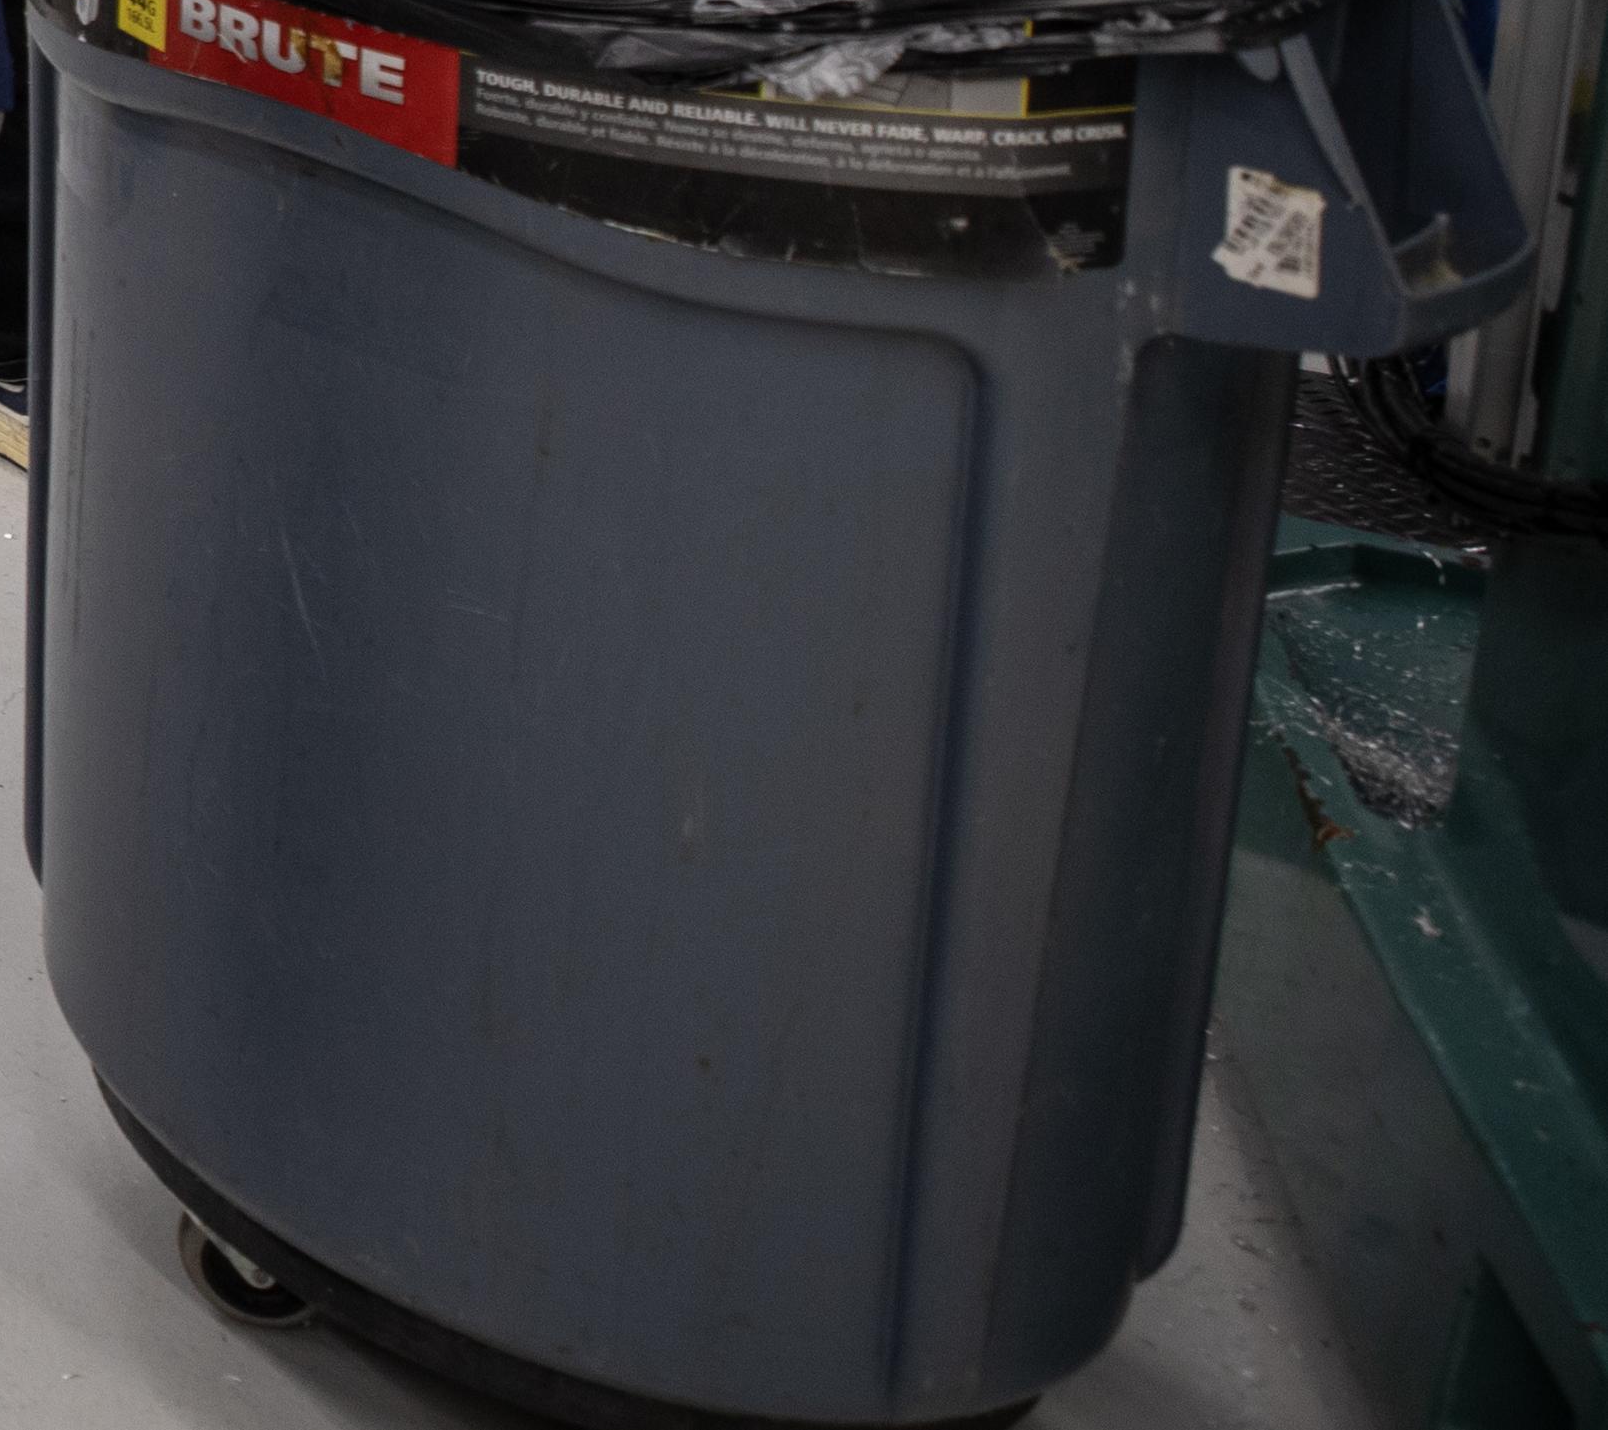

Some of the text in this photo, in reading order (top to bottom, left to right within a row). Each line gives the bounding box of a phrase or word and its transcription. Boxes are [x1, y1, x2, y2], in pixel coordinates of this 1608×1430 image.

[476, 69, 538, 96] TOUGH,
[543, 83, 624, 110] DURABLE
[628, 97, 669, 116] AND
[674, 104, 760, 127] RELIABLE.
[765, 113, 808, 132] WILL
[813, 118, 873, 138] NEVER
[878, 123, 928, 142] FADE,
[1052, 127, 1073, 144] OR
